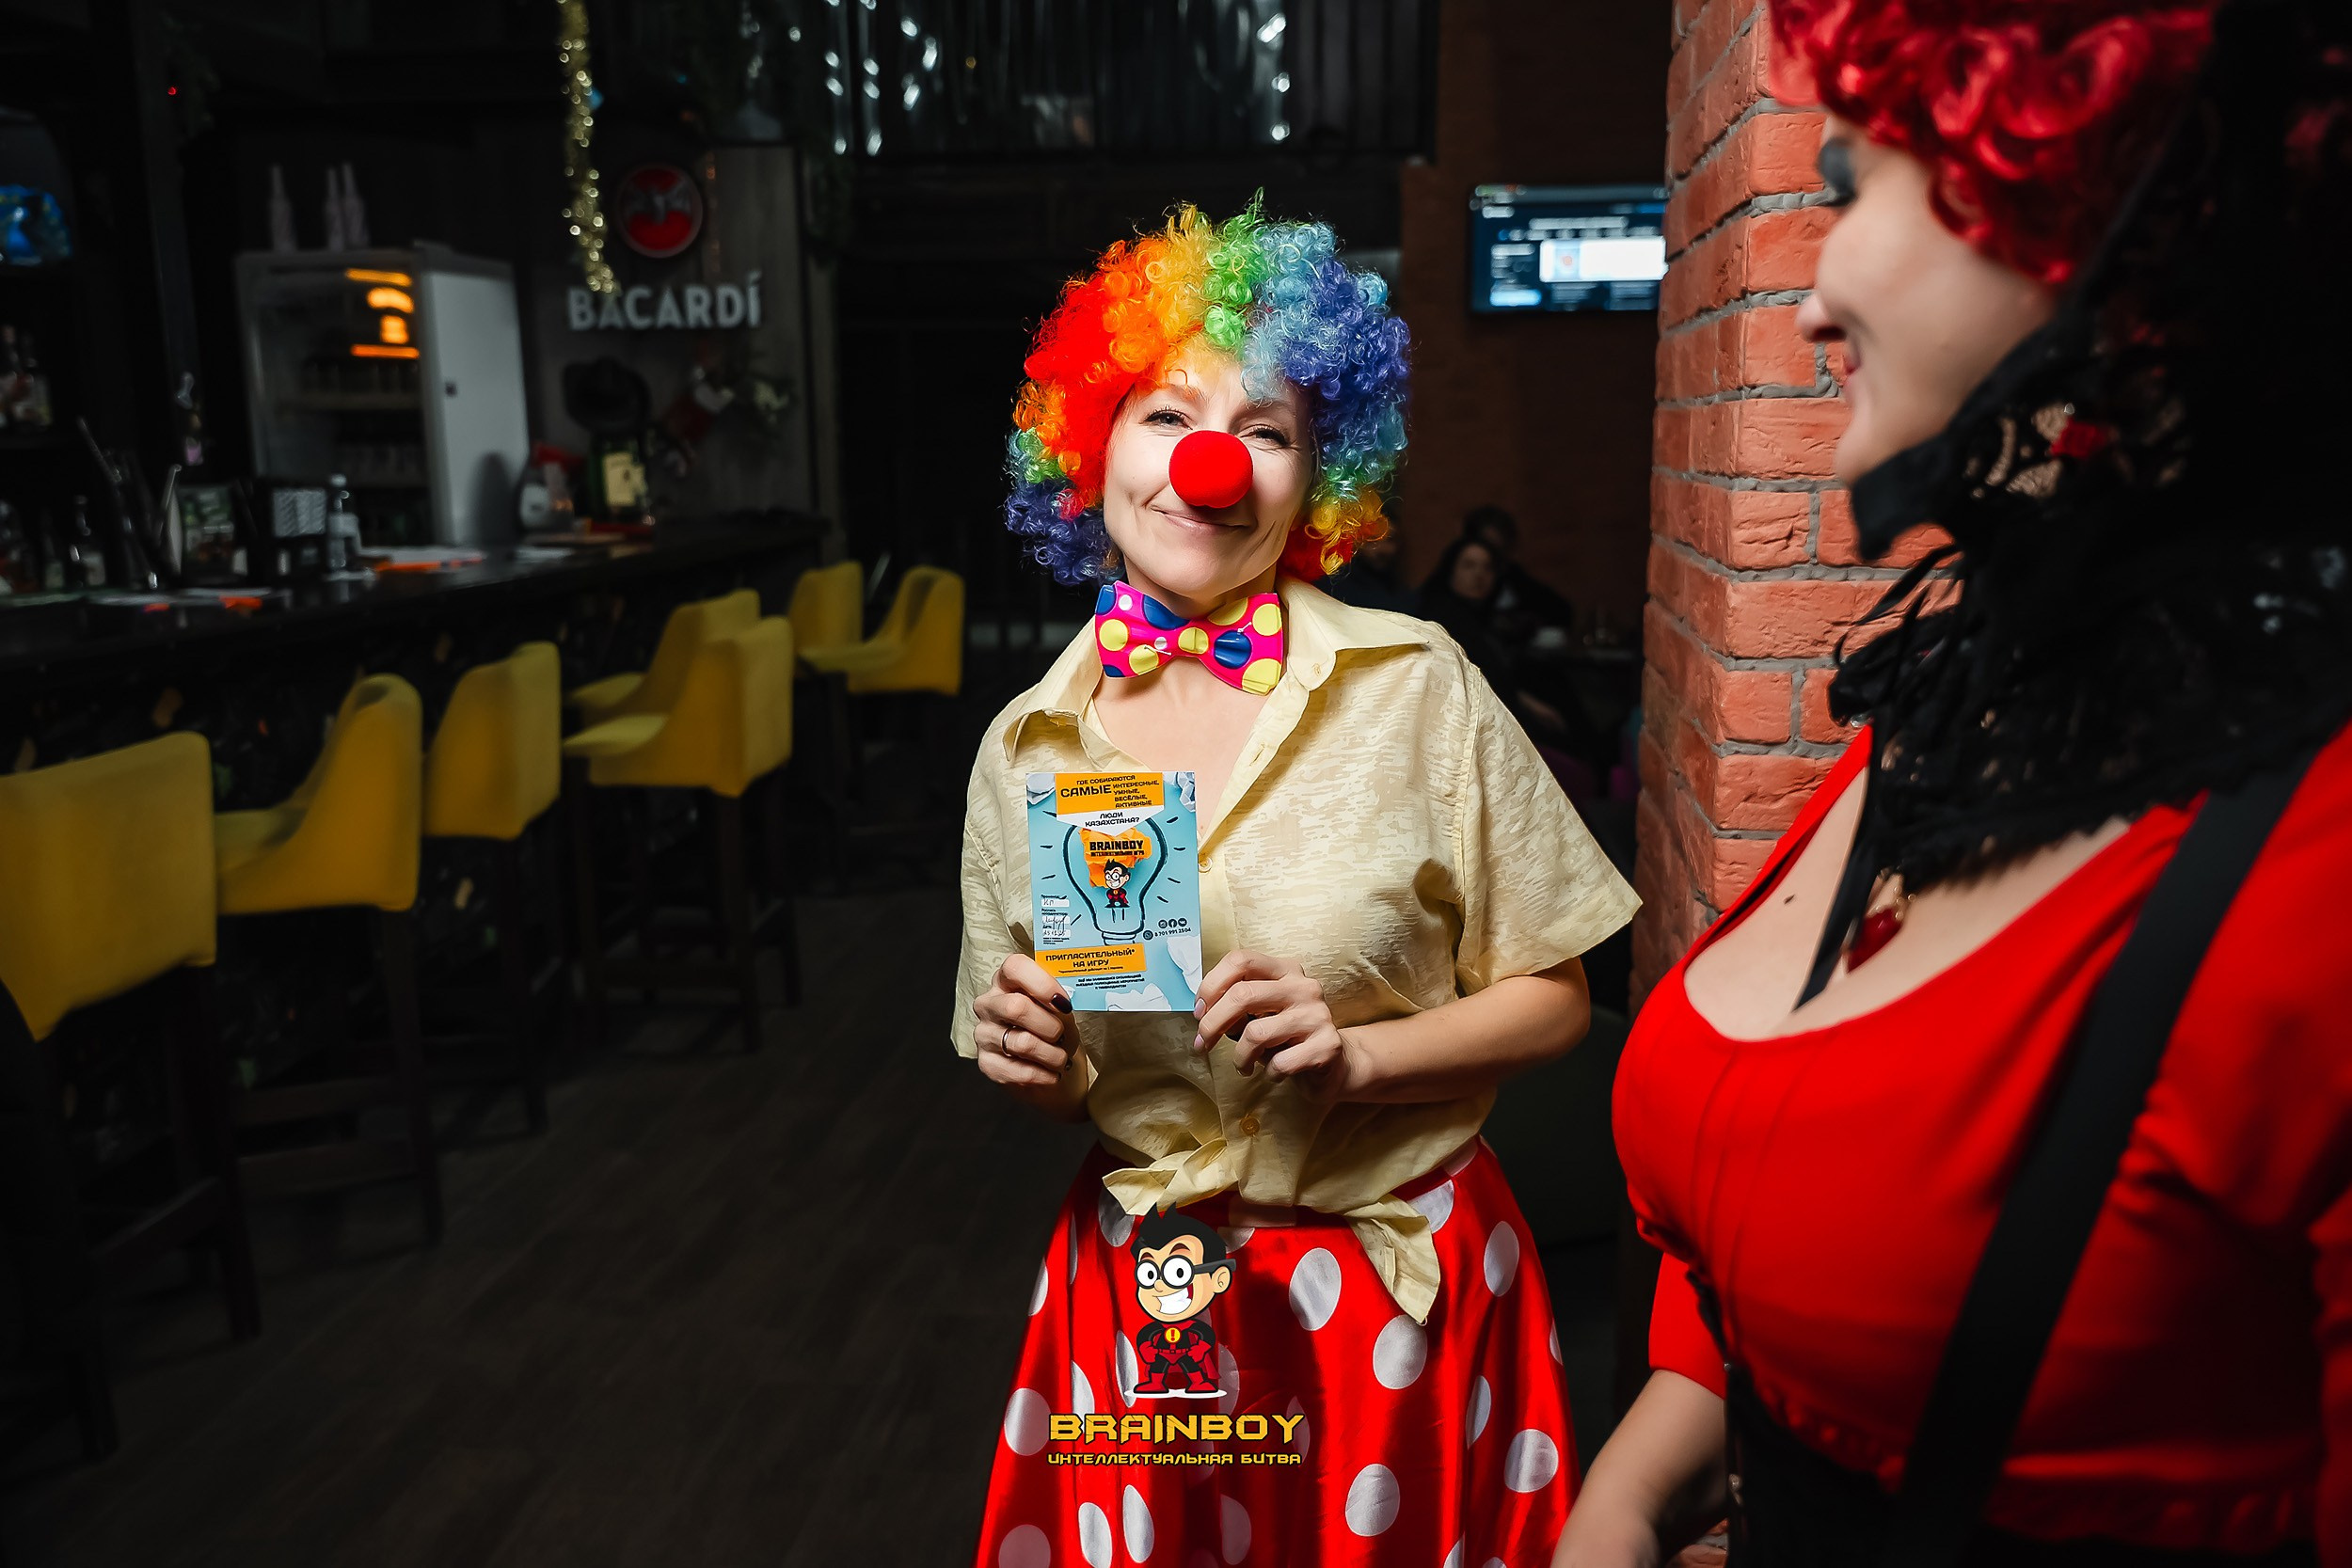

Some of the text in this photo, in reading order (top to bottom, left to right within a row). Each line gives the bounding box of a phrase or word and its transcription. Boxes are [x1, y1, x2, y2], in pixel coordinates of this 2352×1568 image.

[568, 270, 761, 329] BACARDÍ
[1089, 774, 1136, 784] СОБИРАЮТСЯ
[1060, 784, 1112, 798] САМЫЕ
[1085, 816, 1140, 827] КАЗАХСТАНА?
[1089, 840, 1144, 851] BRAINBOY
